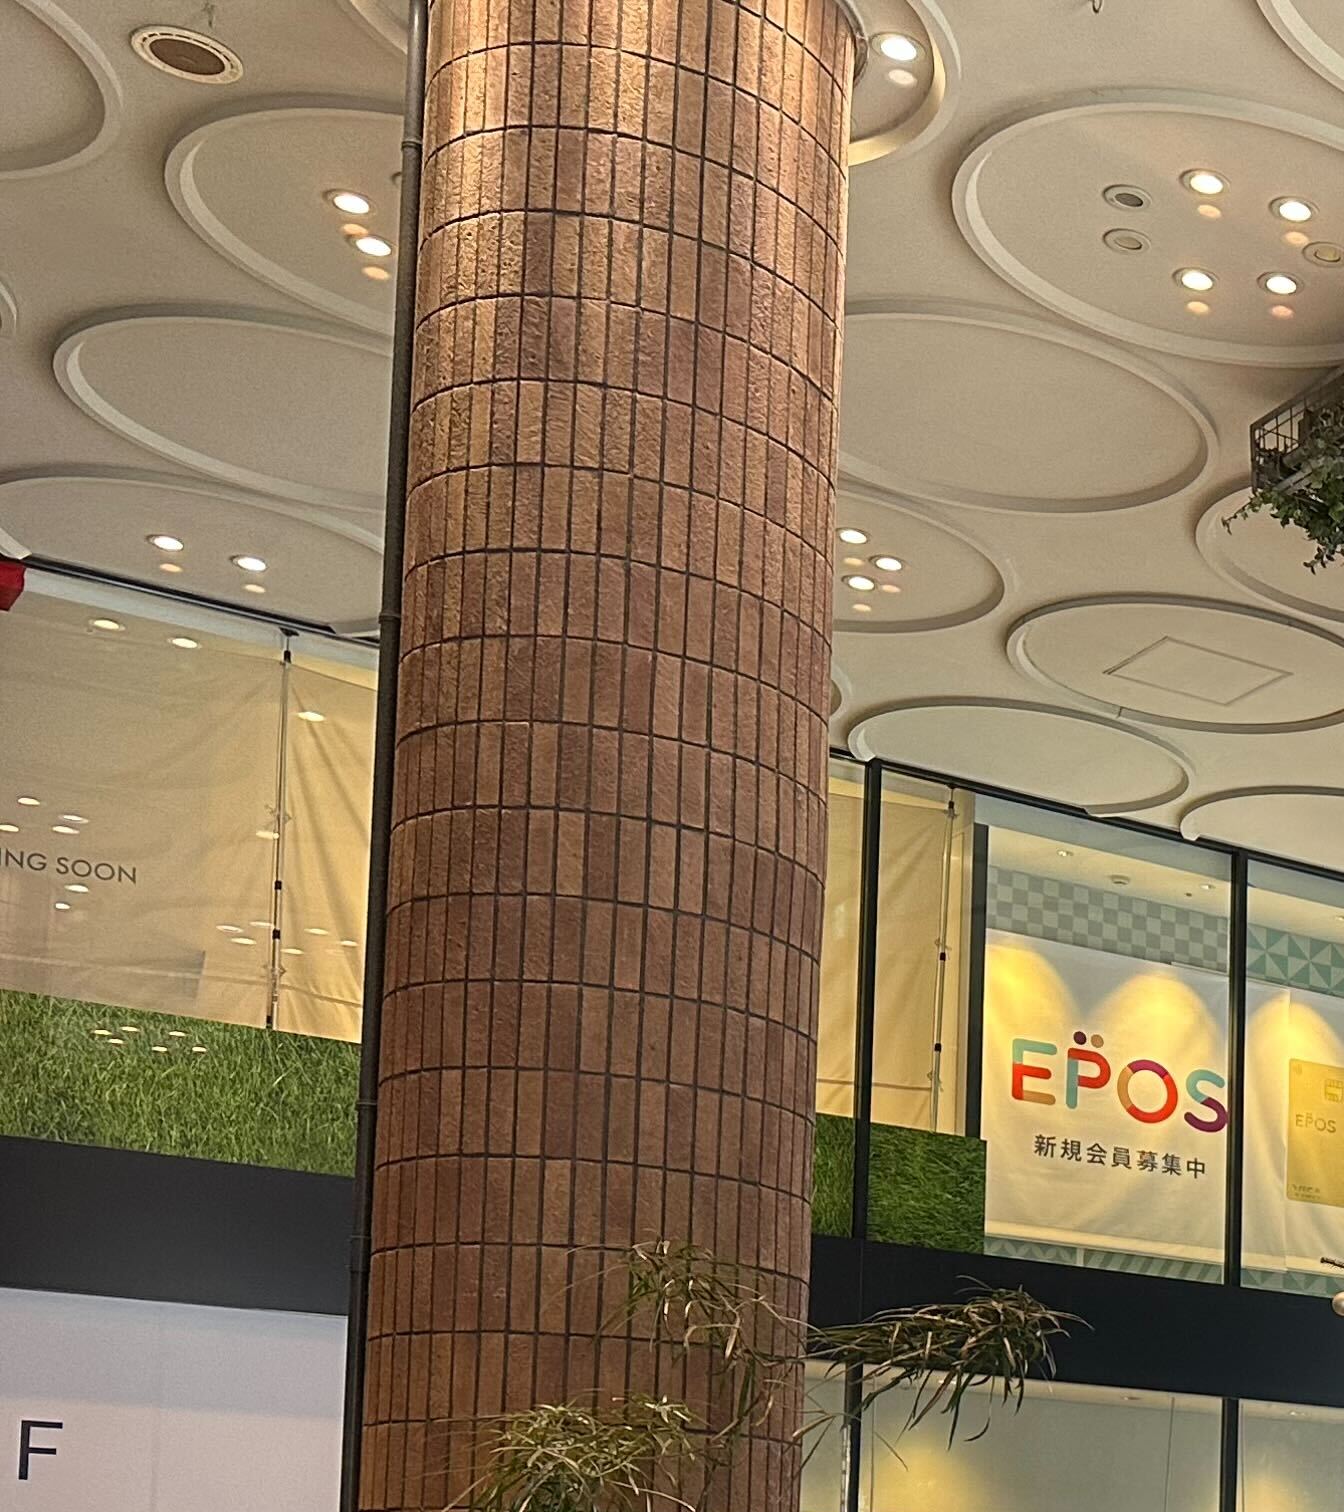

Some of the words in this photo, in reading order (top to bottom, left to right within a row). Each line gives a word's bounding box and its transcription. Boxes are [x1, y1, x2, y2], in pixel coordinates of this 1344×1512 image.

[56, 857, 136, 885] SOON
[1011, 1031, 1228, 1133] EPOS
[1296, 1112, 1336, 1133] EPOS
[1033, 1134, 1205, 1179] 新規会員募集中
[19, 1420, 63, 1480] F
